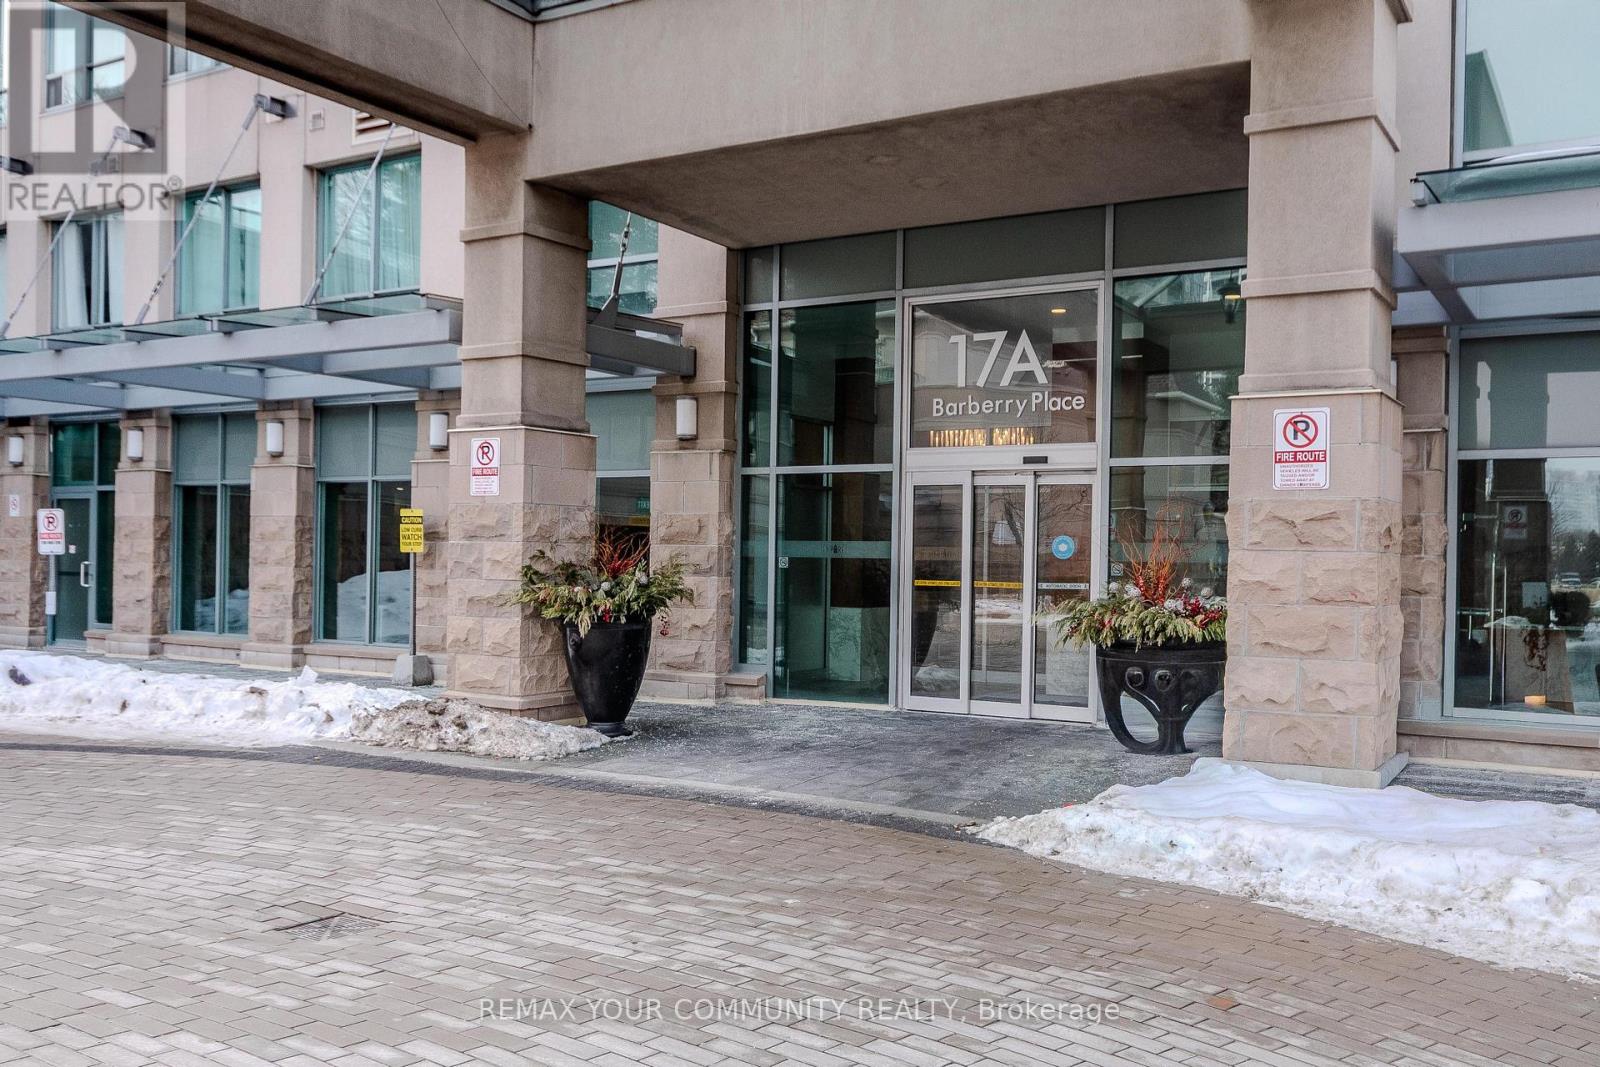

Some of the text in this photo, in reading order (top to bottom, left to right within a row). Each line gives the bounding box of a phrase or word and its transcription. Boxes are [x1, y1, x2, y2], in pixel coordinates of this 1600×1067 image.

[949, 329, 1049, 388] 17A
[932, 391, 1085, 418] Barberry Place
[1276, 451, 1326, 462] FIRE ROUTE
